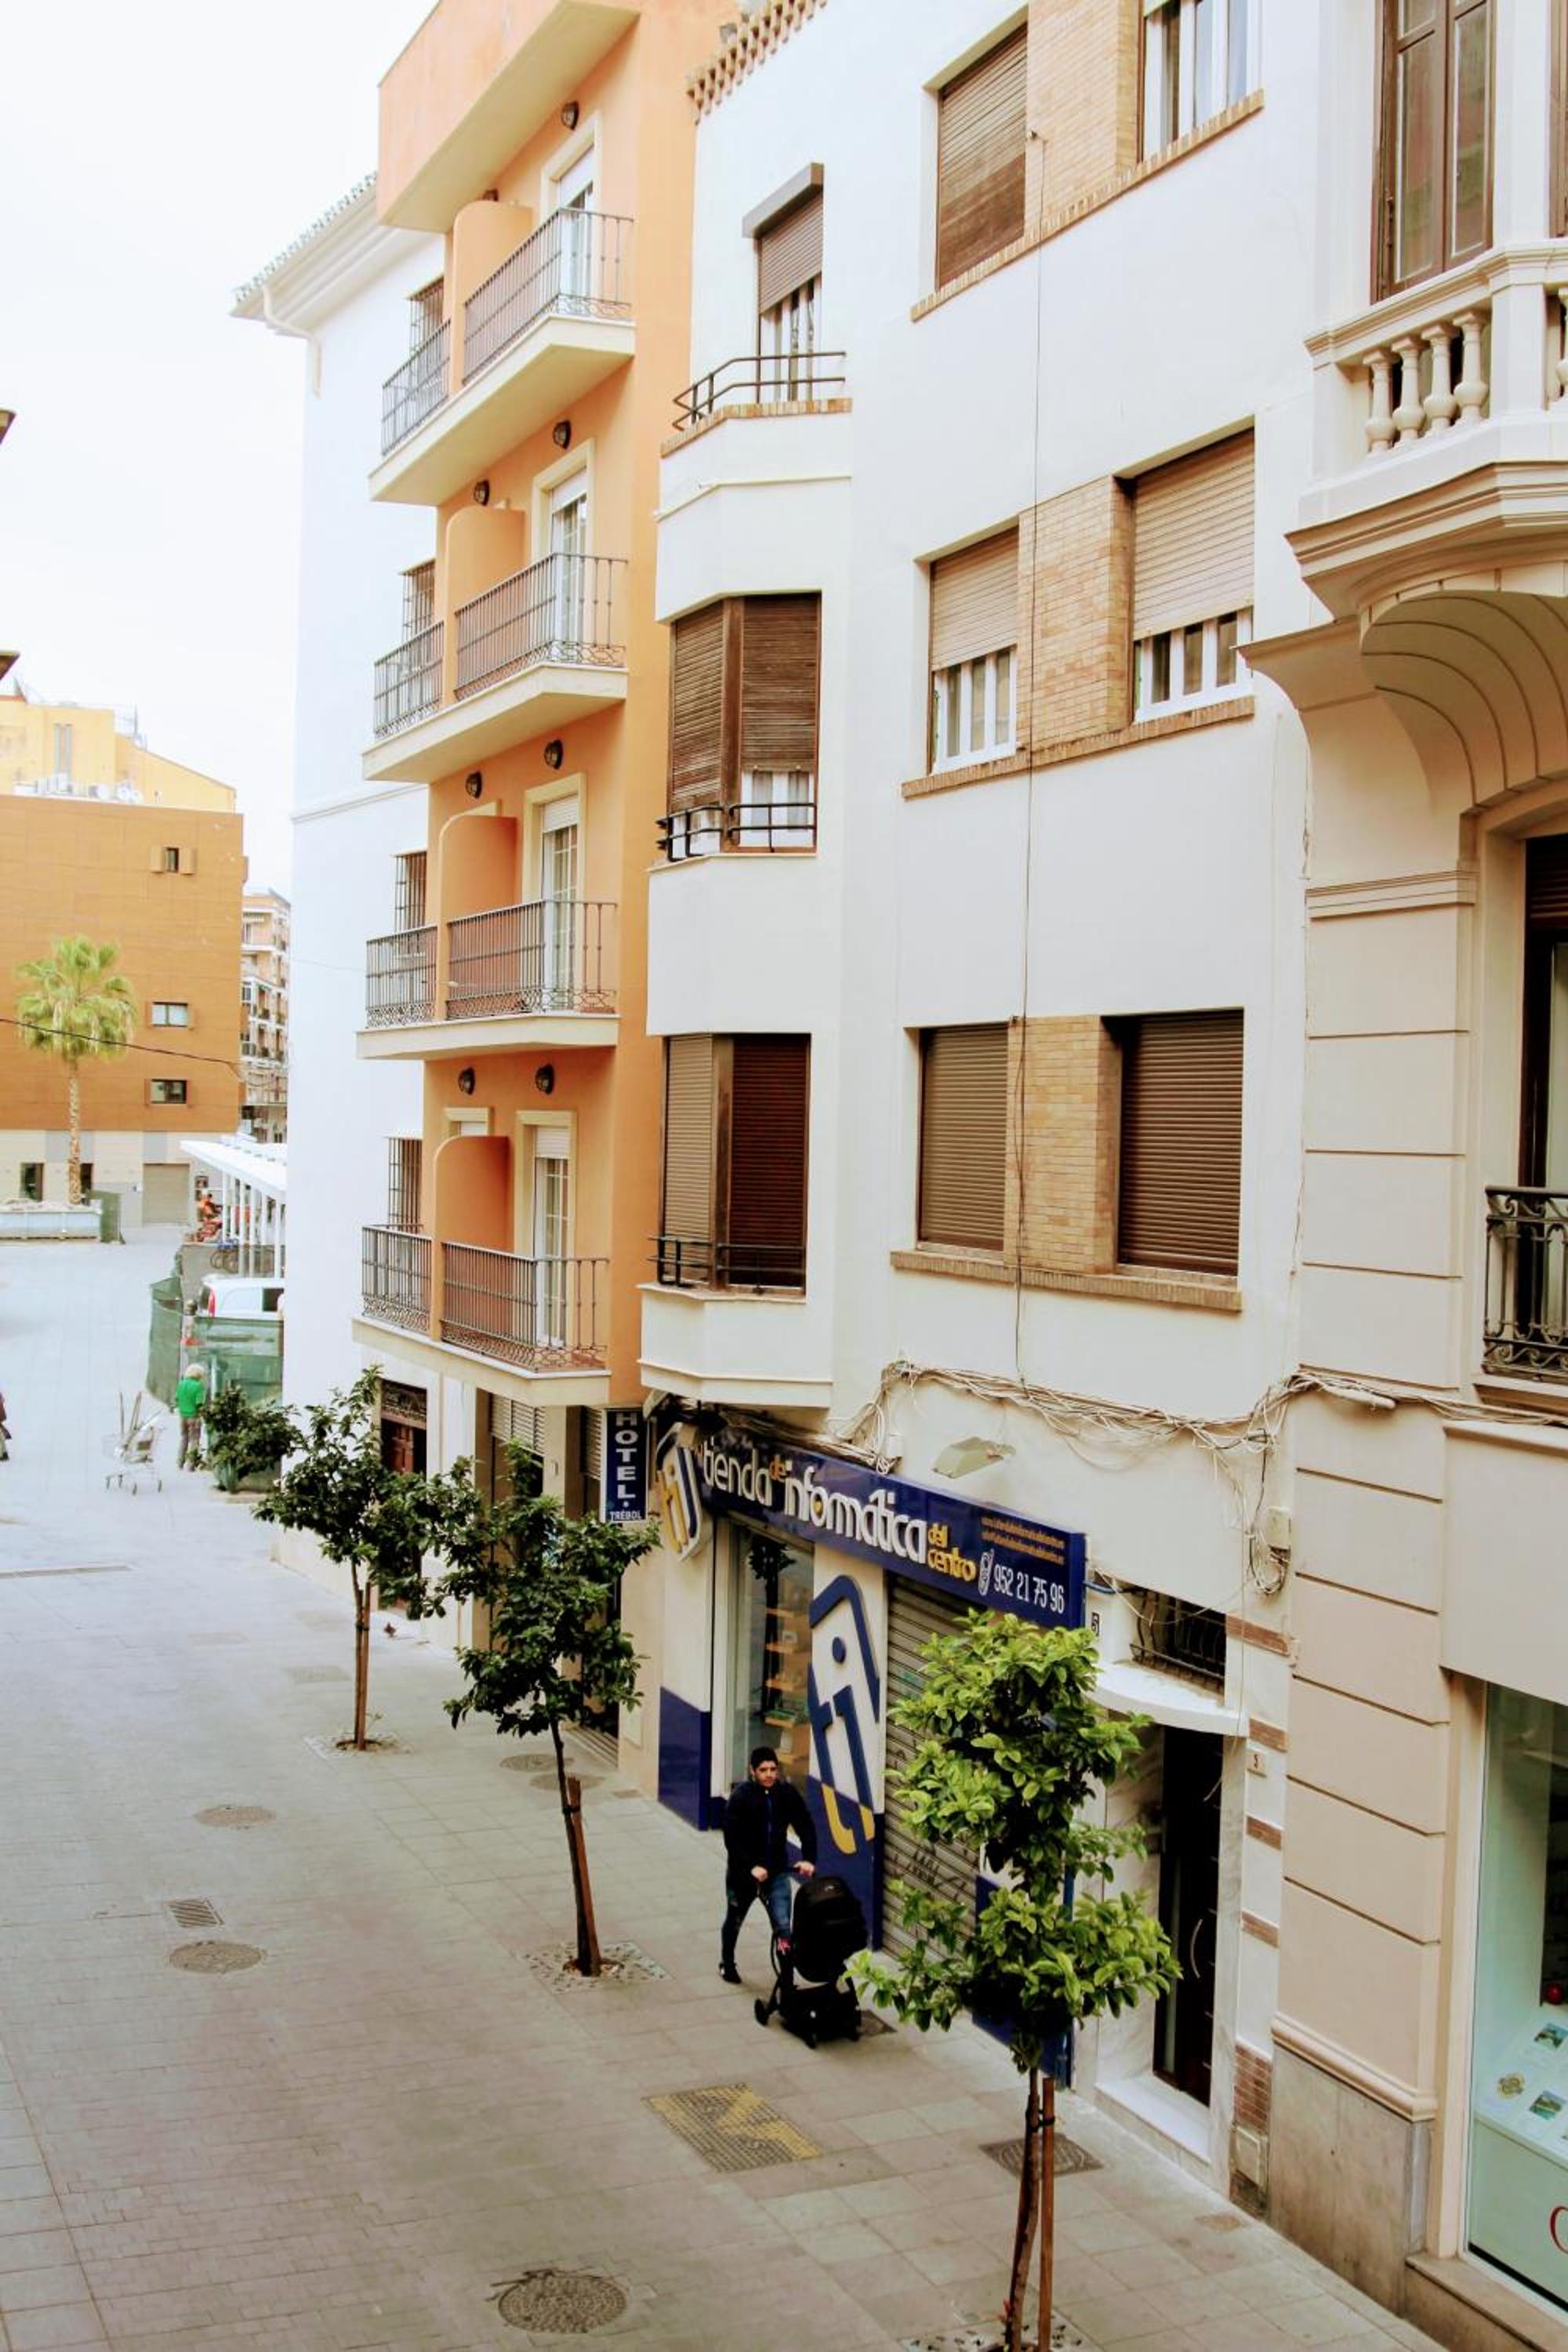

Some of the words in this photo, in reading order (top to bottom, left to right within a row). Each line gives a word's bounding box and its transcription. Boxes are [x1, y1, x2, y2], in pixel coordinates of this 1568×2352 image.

[615, 1413, 638, 1499] HOTEL
[703, 1436, 772, 1506] tienda
[928, 1523, 948, 1548] del
[928, 1548, 976, 1581] centro
[994, 1564, 1014, 1597] 952
[1017, 1572, 1029, 1602] 21
[1033, 1577, 1047, 1608] 75
[1050, 1582, 1065, 1614] 96
